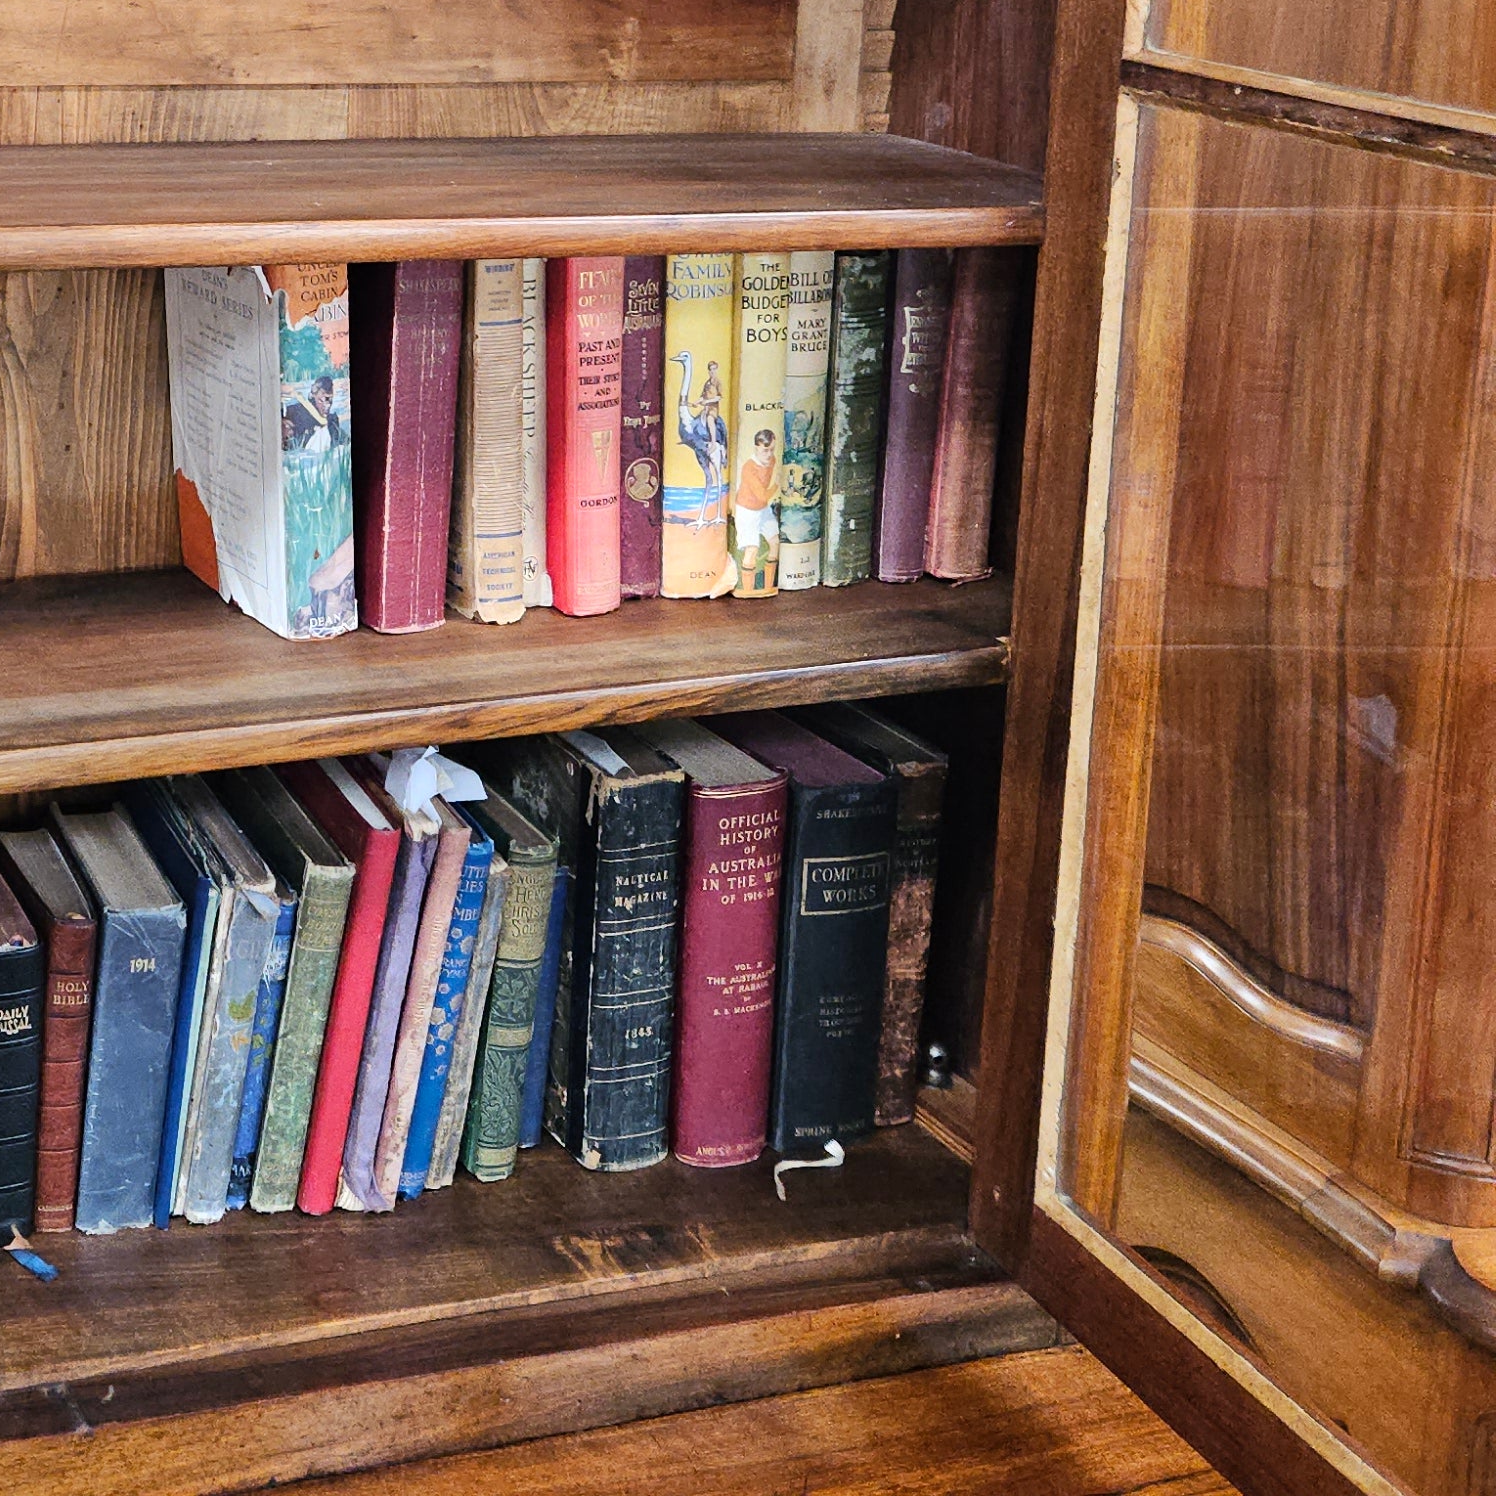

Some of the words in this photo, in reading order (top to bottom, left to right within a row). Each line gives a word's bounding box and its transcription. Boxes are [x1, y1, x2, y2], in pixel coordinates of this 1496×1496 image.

[672, 261, 732, 281] FAMILY
[760, 263, 781, 272] THE
[300, 269, 338, 288] TOM'S
[790, 271, 820, 287] BILL
[301, 286, 339, 303] CABIN
[757, 313, 780, 323] FOR
[797, 317, 827, 329] MARY
[746, 327, 787, 343] BOYS
[791, 329, 828, 341] GRANT
[578, 341, 603, 353] PAST
[605, 338, 621, 351] AND
[791, 340, 827, 352] BRUCE
[579, 352, 621, 368] PRESENT
[578, 375, 601, 386] THEIR
[594, 387, 612, 397] AND
[580, 495, 618, 508] GORDON
[690, 570, 717, 579] DEAN
[309, 616, 341, 627] DEAN
[719, 809, 780, 830] OFFICIAL
[720, 825, 778, 846] HISTORY
[744, 845, 756, 854] OF
[615, 870, 669, 887] NAUTICAL
[703, 878, 720, 891] IN
[727, 874, 757, 890] THE
[614, 891, 668, 908] MAGAZINE
[721, 894, 736, 905] OF
[822, 884, 878, 904] WORKS
[130, 957, 155, 973] 1914
[56, 980, 89, 993] HOLY
[707, 975, 727, 986] THE
[722, 987, 735, 996] AT
[53, 993, 90, 1005] BIBLE
